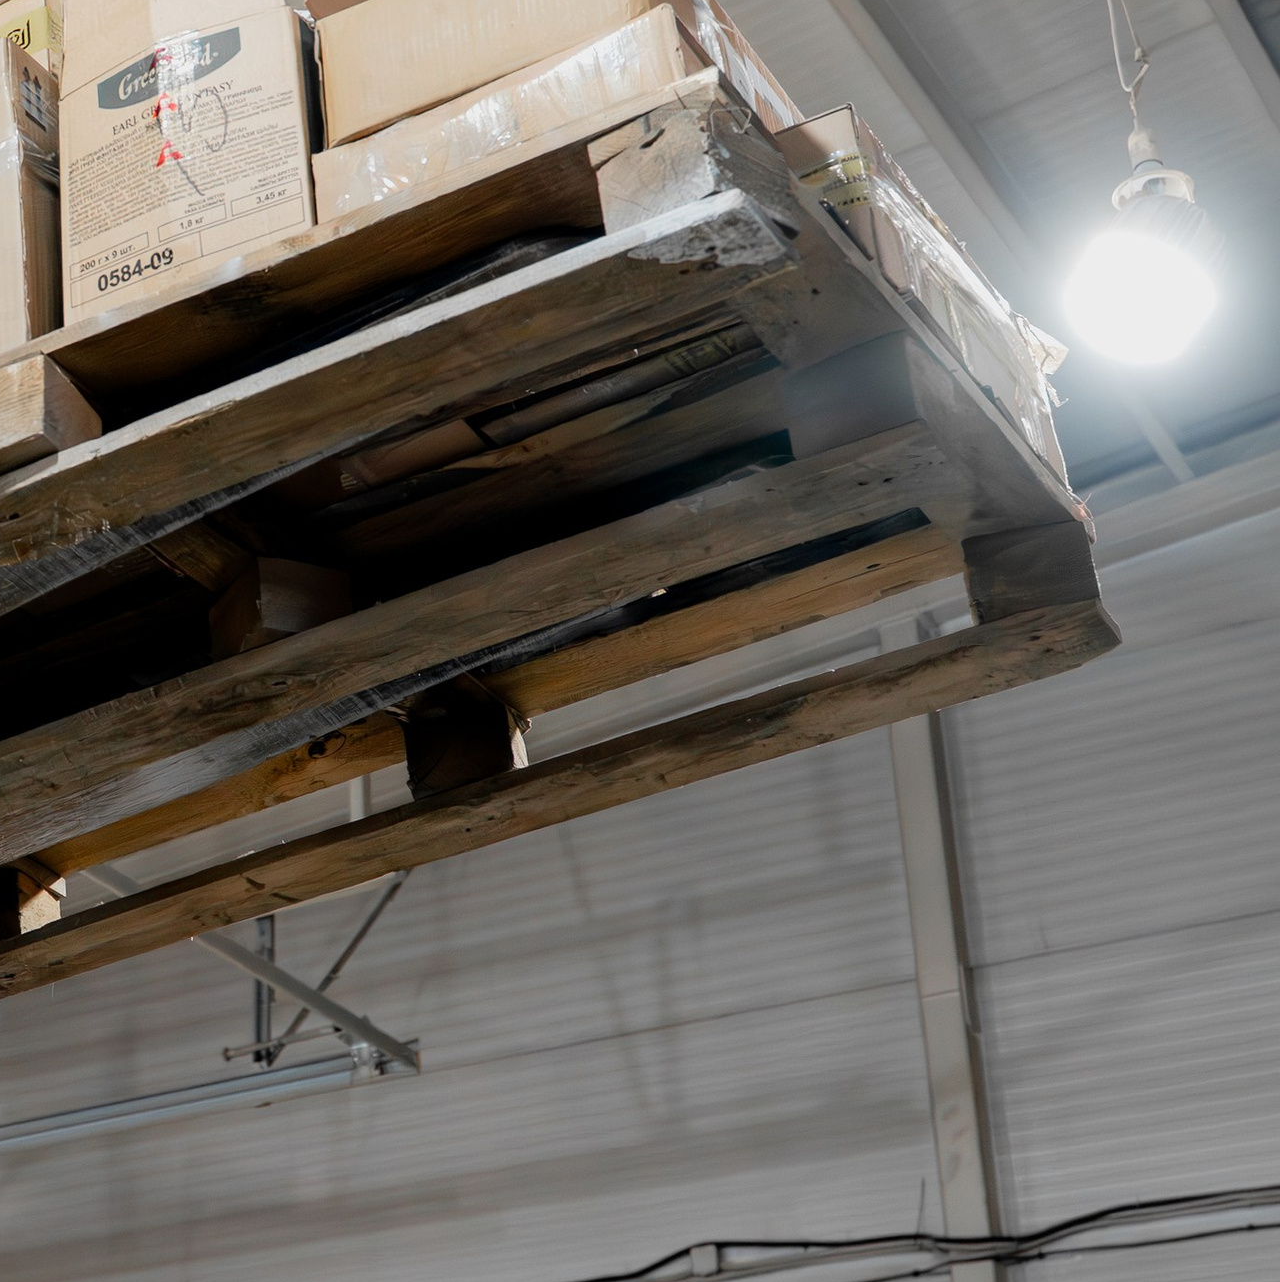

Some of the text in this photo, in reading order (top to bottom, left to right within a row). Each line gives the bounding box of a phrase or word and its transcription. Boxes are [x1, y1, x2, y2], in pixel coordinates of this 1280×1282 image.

[111, 115, 138, 136] EARL
[255, 188, 288, 205] 3,45 кг
[179, 216, 205, 231] 1,8 кг
[80, 259, 96, 273] 200
[111, 250, 118, 259] 9
[119, 244, 136, 256] шт.
[97, 247, 174, 292] 0584-09
